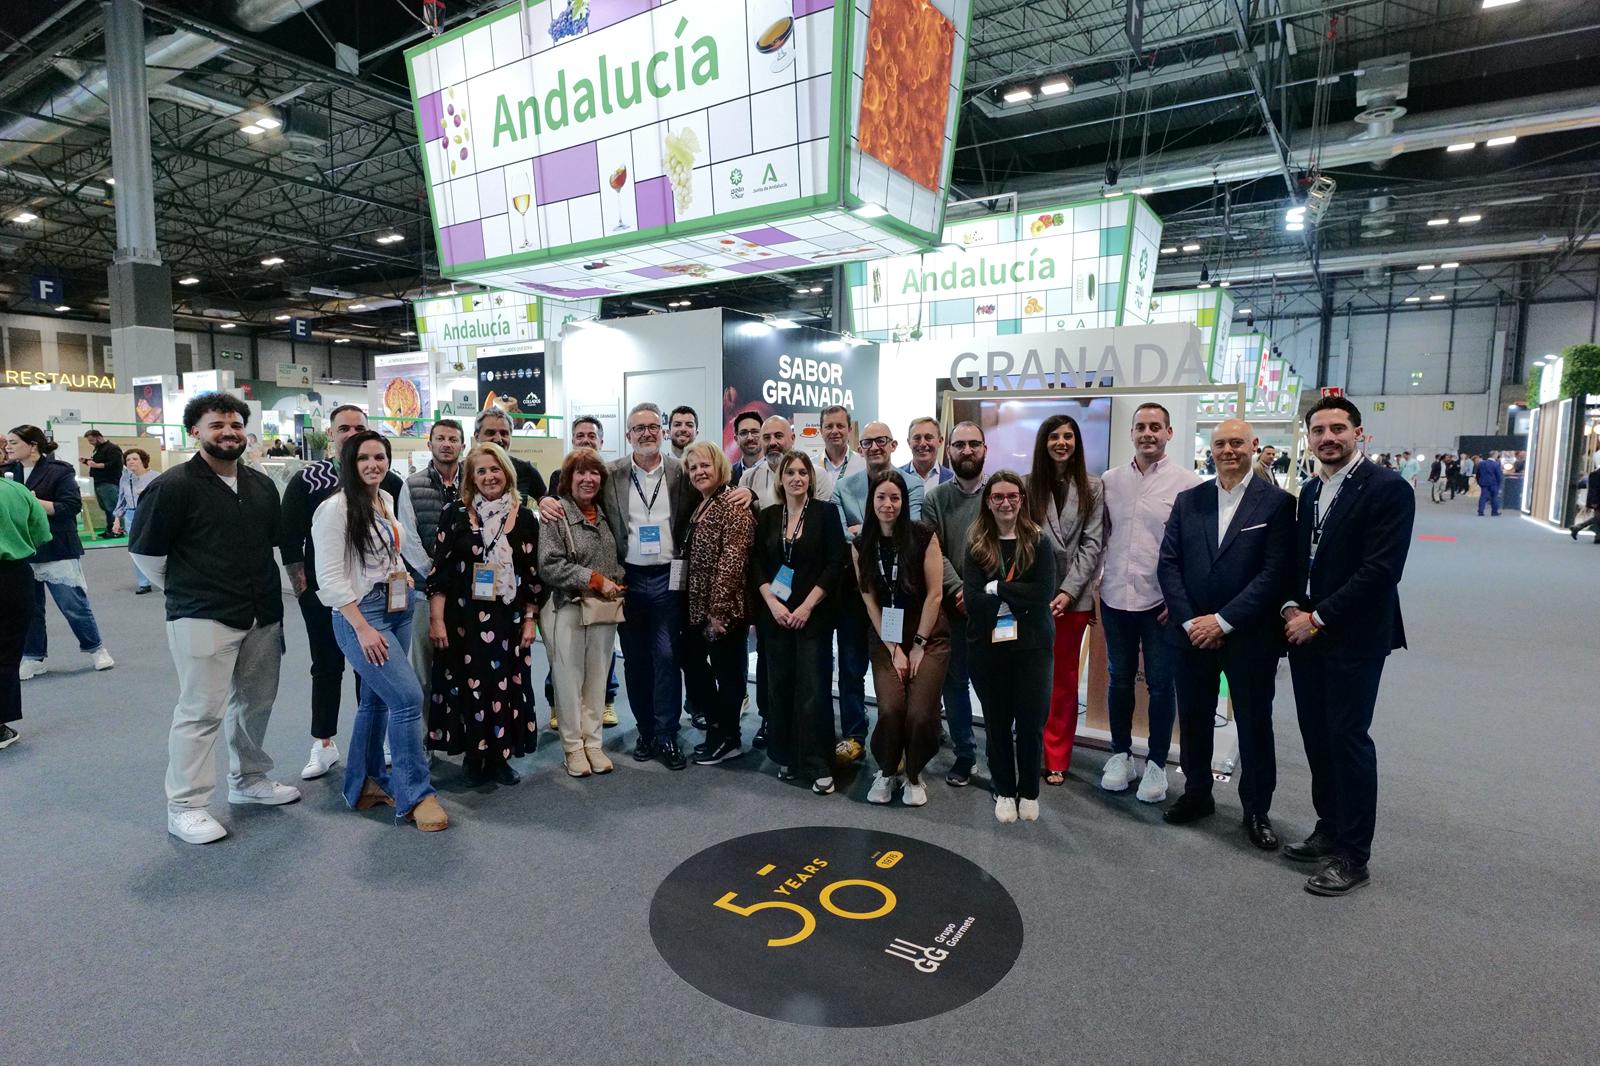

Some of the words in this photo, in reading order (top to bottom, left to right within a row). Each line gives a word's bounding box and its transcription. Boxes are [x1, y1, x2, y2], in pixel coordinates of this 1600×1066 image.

[493, 16, 719, 148] Andalucía
[902, 247, 1055, 294] Andalucía
[40, 280, 54, 299] F
[296, 320, 306, 336] E
[443, 313, 511, 341] Andalucía
[5, 370, 116, 390] RESTAURA
[778, 354, 843, 386] SABOR
[950, 340, 1210, 392] GRANADA
[762, 379, 855, 410] GRANADA
[773, 857, 829, 897] YEARS
[934, 923, 956, 943] Grupo
[946, 916, 976, 947] Gourmets
